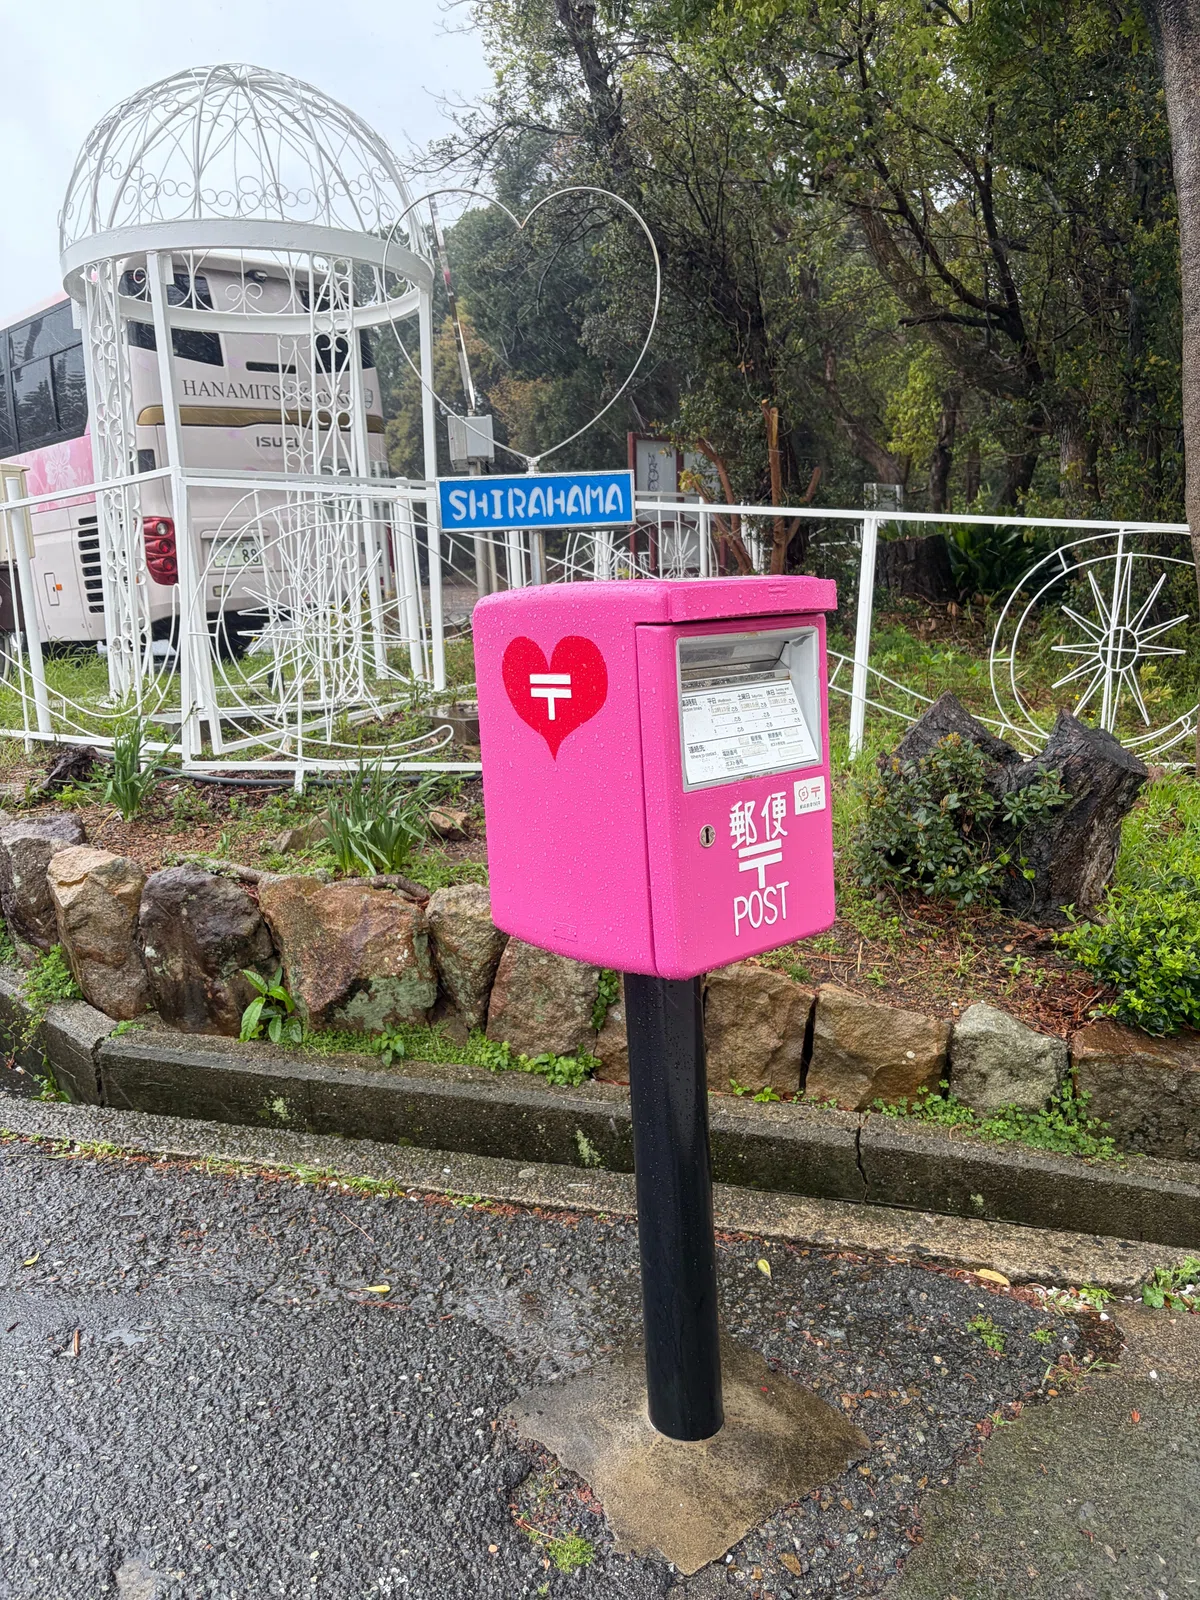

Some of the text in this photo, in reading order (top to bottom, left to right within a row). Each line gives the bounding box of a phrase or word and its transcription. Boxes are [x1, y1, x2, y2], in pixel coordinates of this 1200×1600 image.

[448, 483, 624, 521] SHIRAHAMA
[729, 791, 788, 849] 郵便
[733, 881, 790, 936] POST
